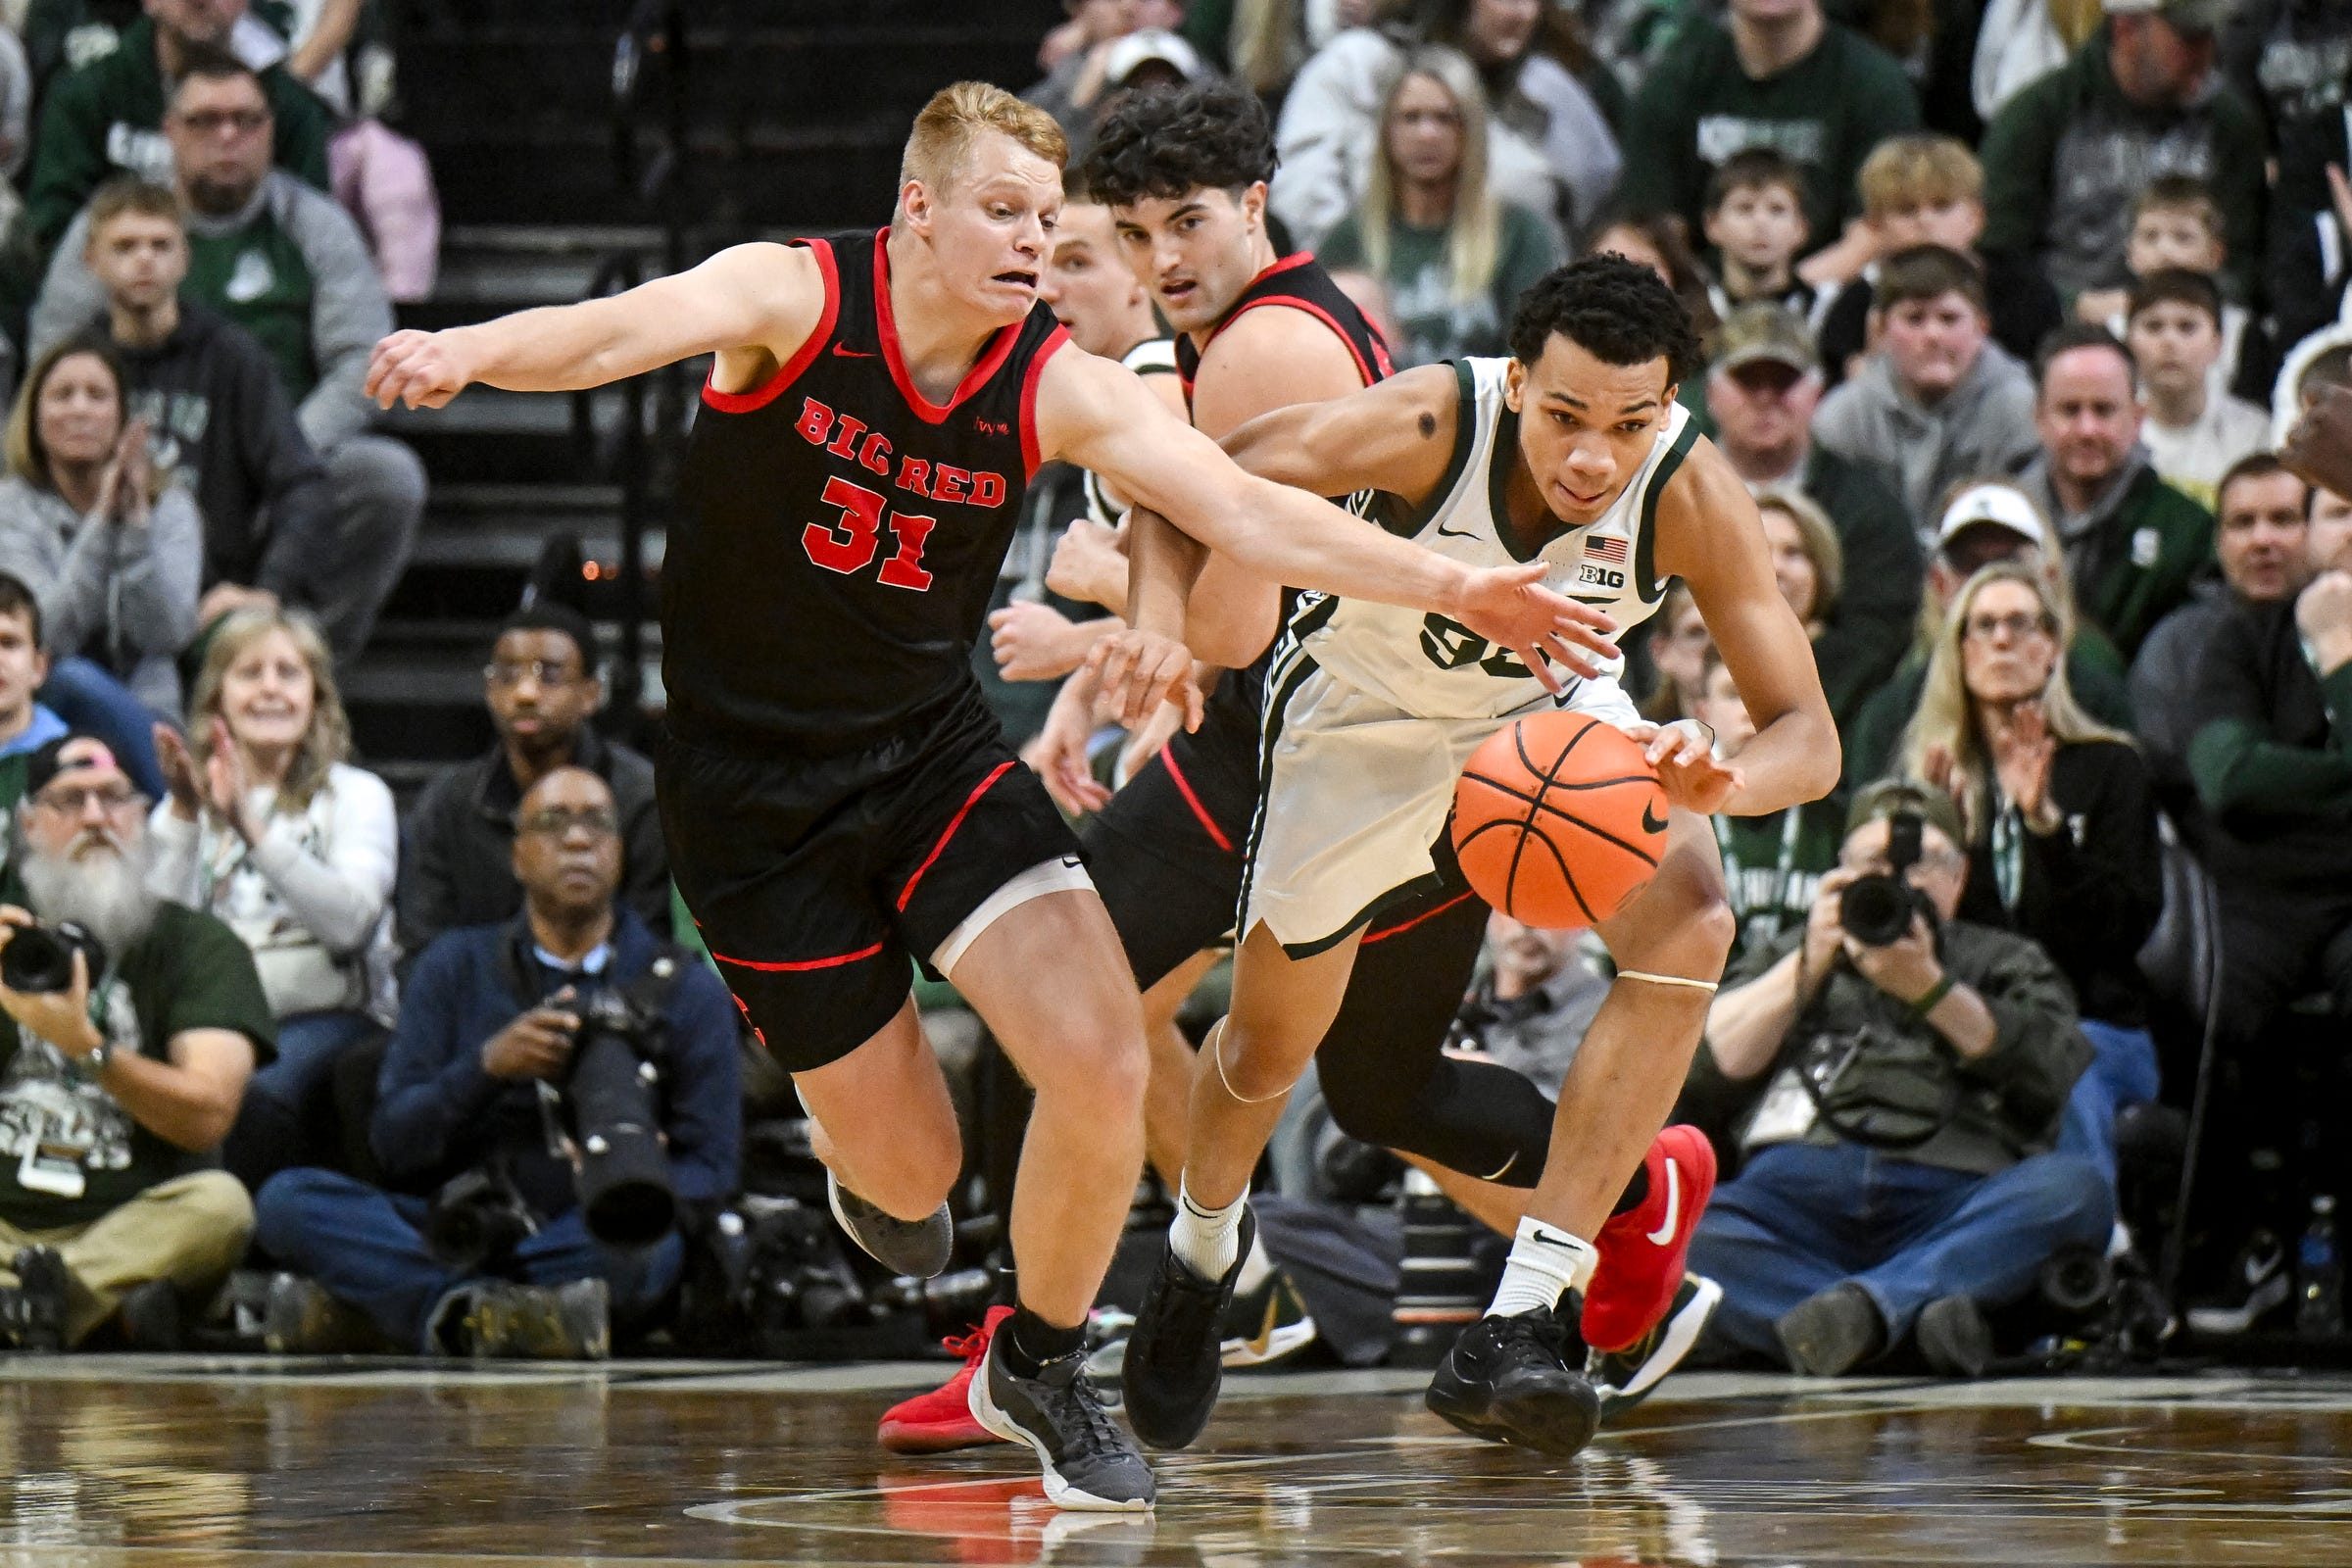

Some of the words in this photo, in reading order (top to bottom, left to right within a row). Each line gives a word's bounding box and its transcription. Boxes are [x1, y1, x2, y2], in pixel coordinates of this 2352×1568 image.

[795, 396, 893, 476] BIG
[895, 455, 1006, 509] RED
[801, 475, 937, 592] 31
